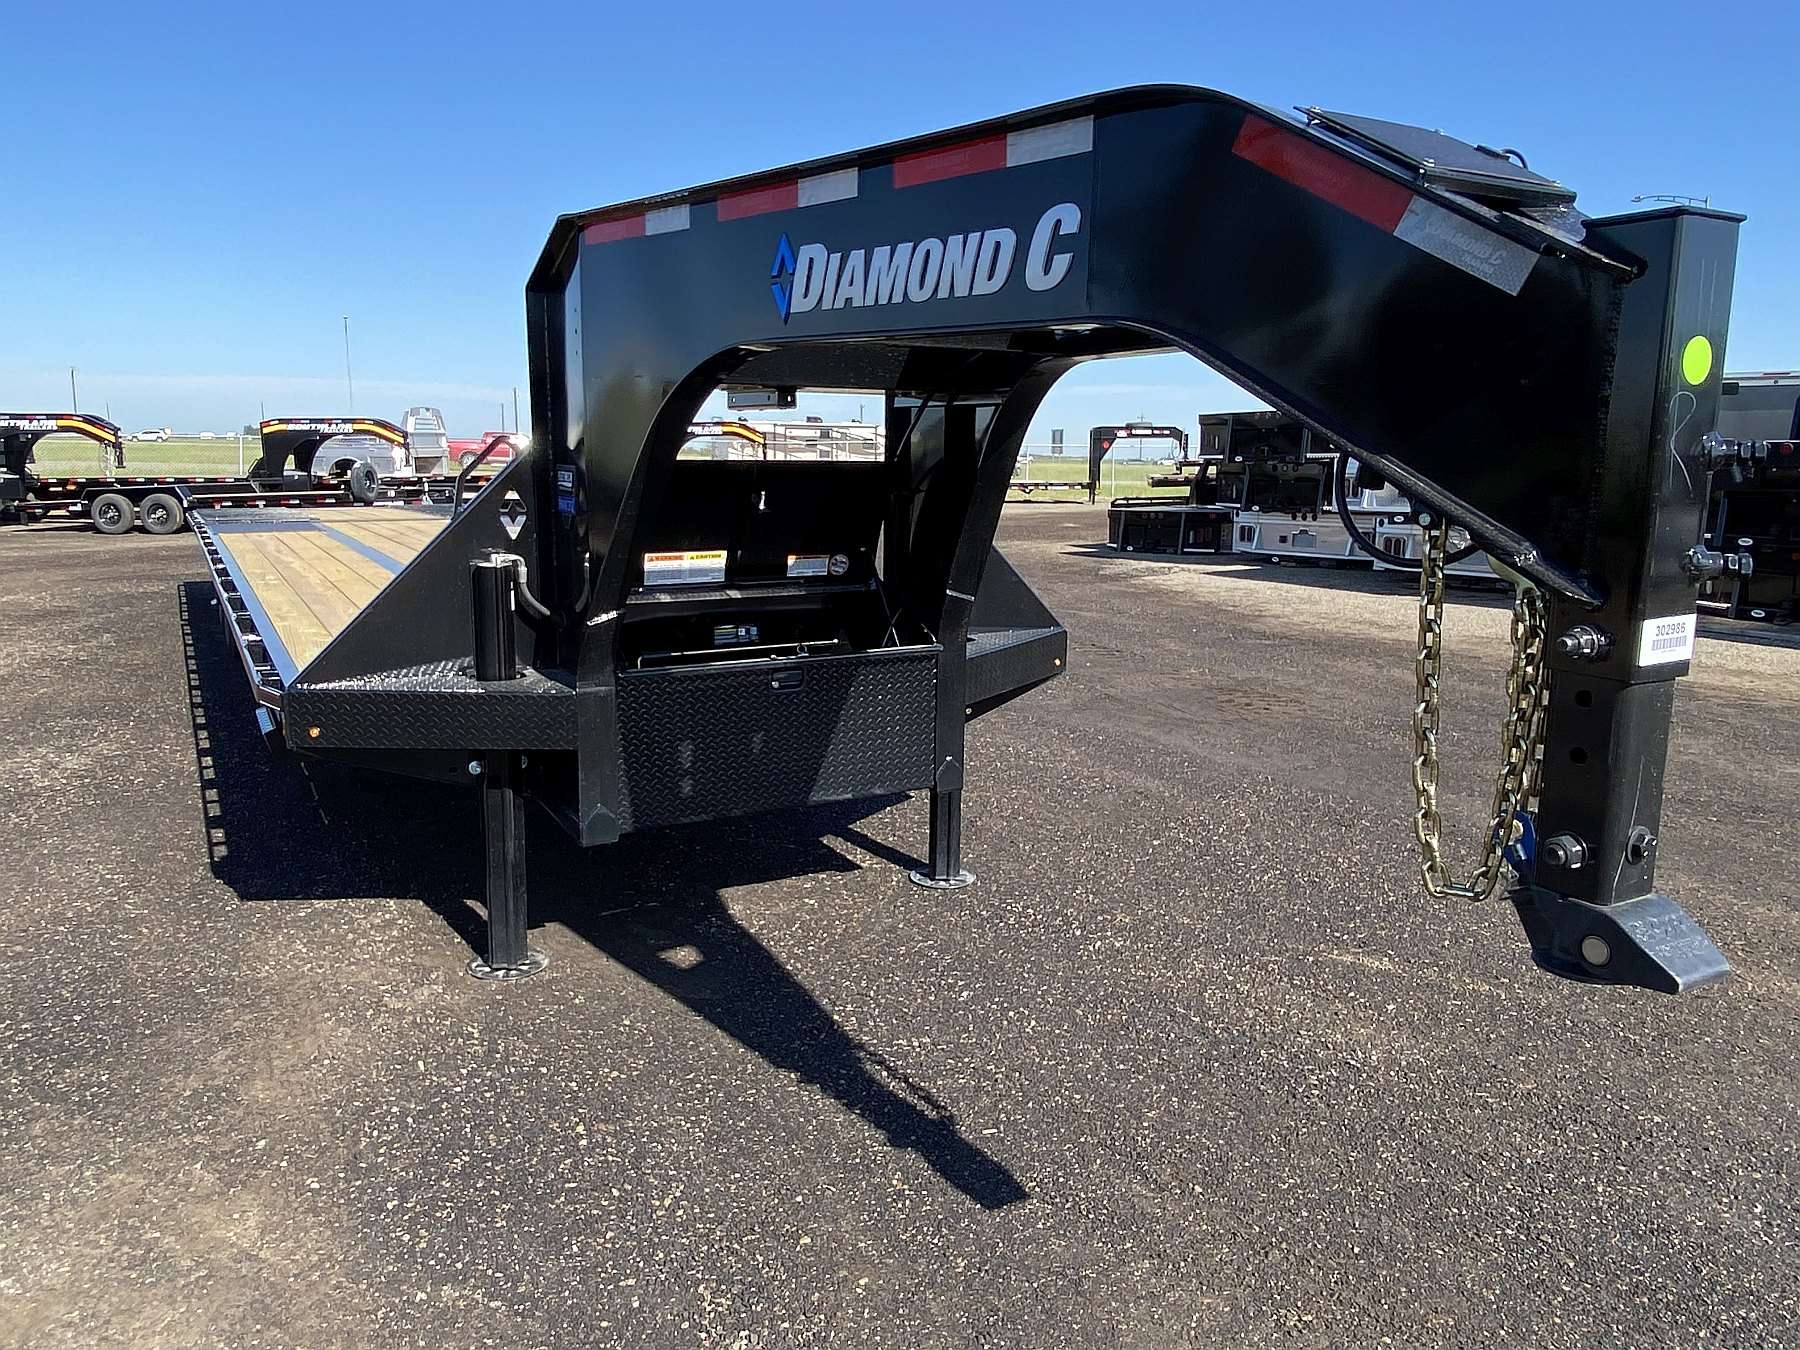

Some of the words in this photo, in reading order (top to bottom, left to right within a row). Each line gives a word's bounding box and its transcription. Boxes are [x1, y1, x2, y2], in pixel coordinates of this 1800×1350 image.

[790, 227, 1018, 314] DIAMOND
[1025, 202, 1082, 292] C
[1655, 622, 1687, 637] 302986
